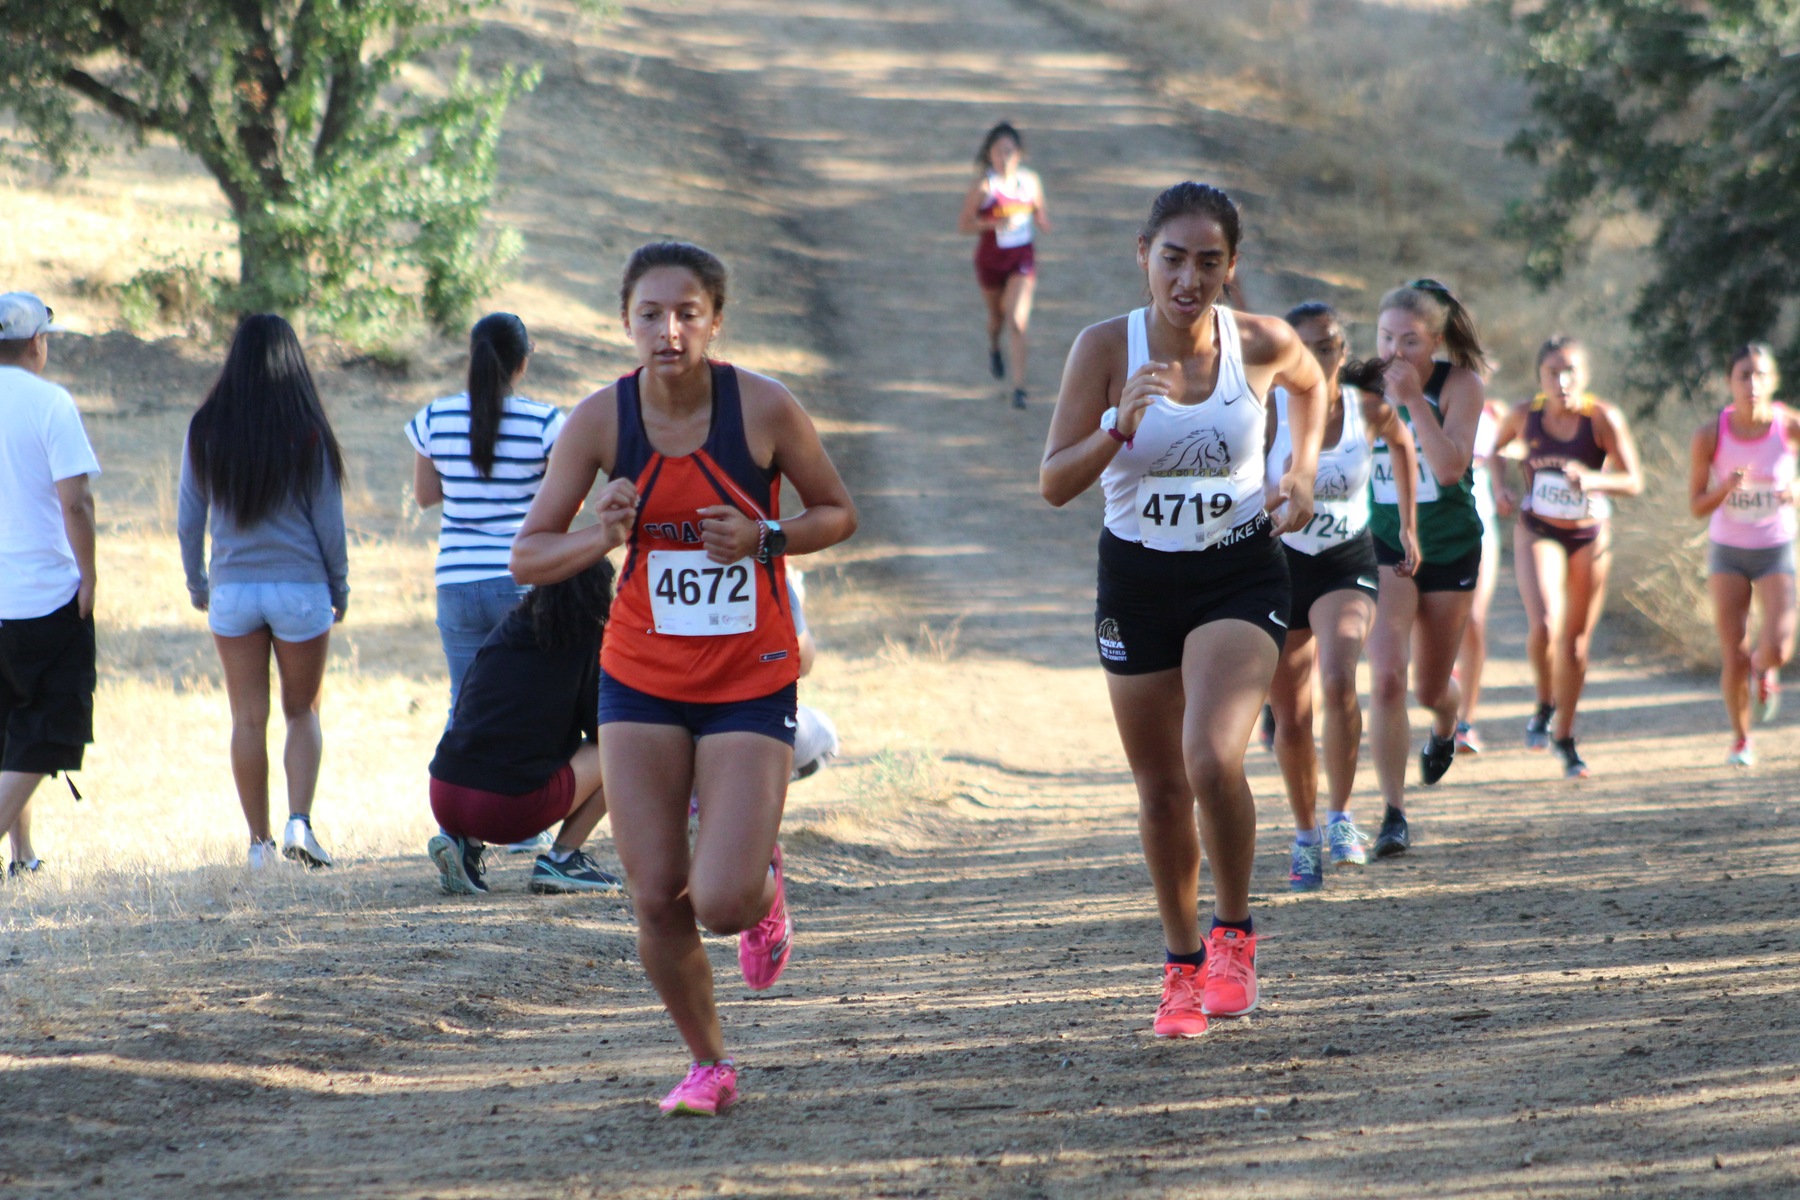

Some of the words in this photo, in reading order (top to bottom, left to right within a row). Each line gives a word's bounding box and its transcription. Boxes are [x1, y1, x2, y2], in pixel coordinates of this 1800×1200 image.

[1375, 463, 1426, 485] 441
[1142, 492, 1233, 527] 4719
[643, 521, 704, 544] COA
[1217, 522, 1254, 549] NIKE
[1302, 513, 1348, 540] 724
[656, 565, 750, 606] 4672
